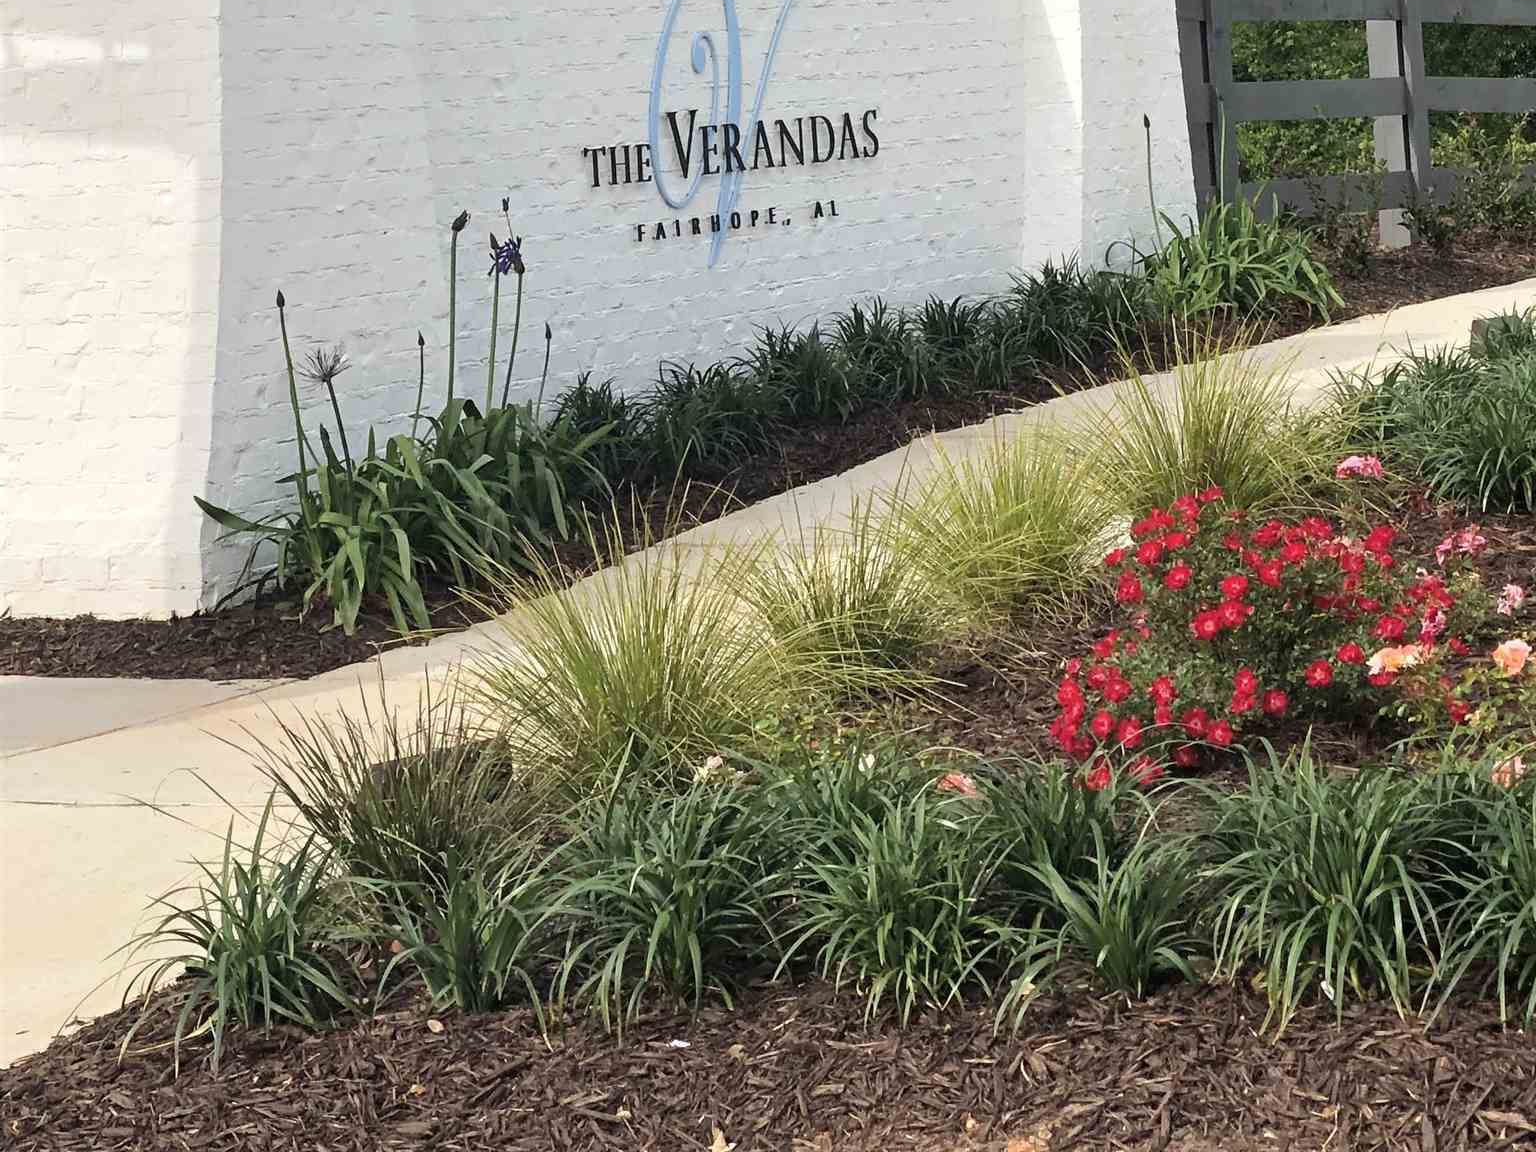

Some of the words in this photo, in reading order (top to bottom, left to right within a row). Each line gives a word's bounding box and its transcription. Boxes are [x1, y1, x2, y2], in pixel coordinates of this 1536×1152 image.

[583, 144, 653, 188] THE
[666, 109, 881, 179] VERANDAS
[636, 208, 791, 242] FAIRHOPE,
[813, 200, 840, 219] AL
